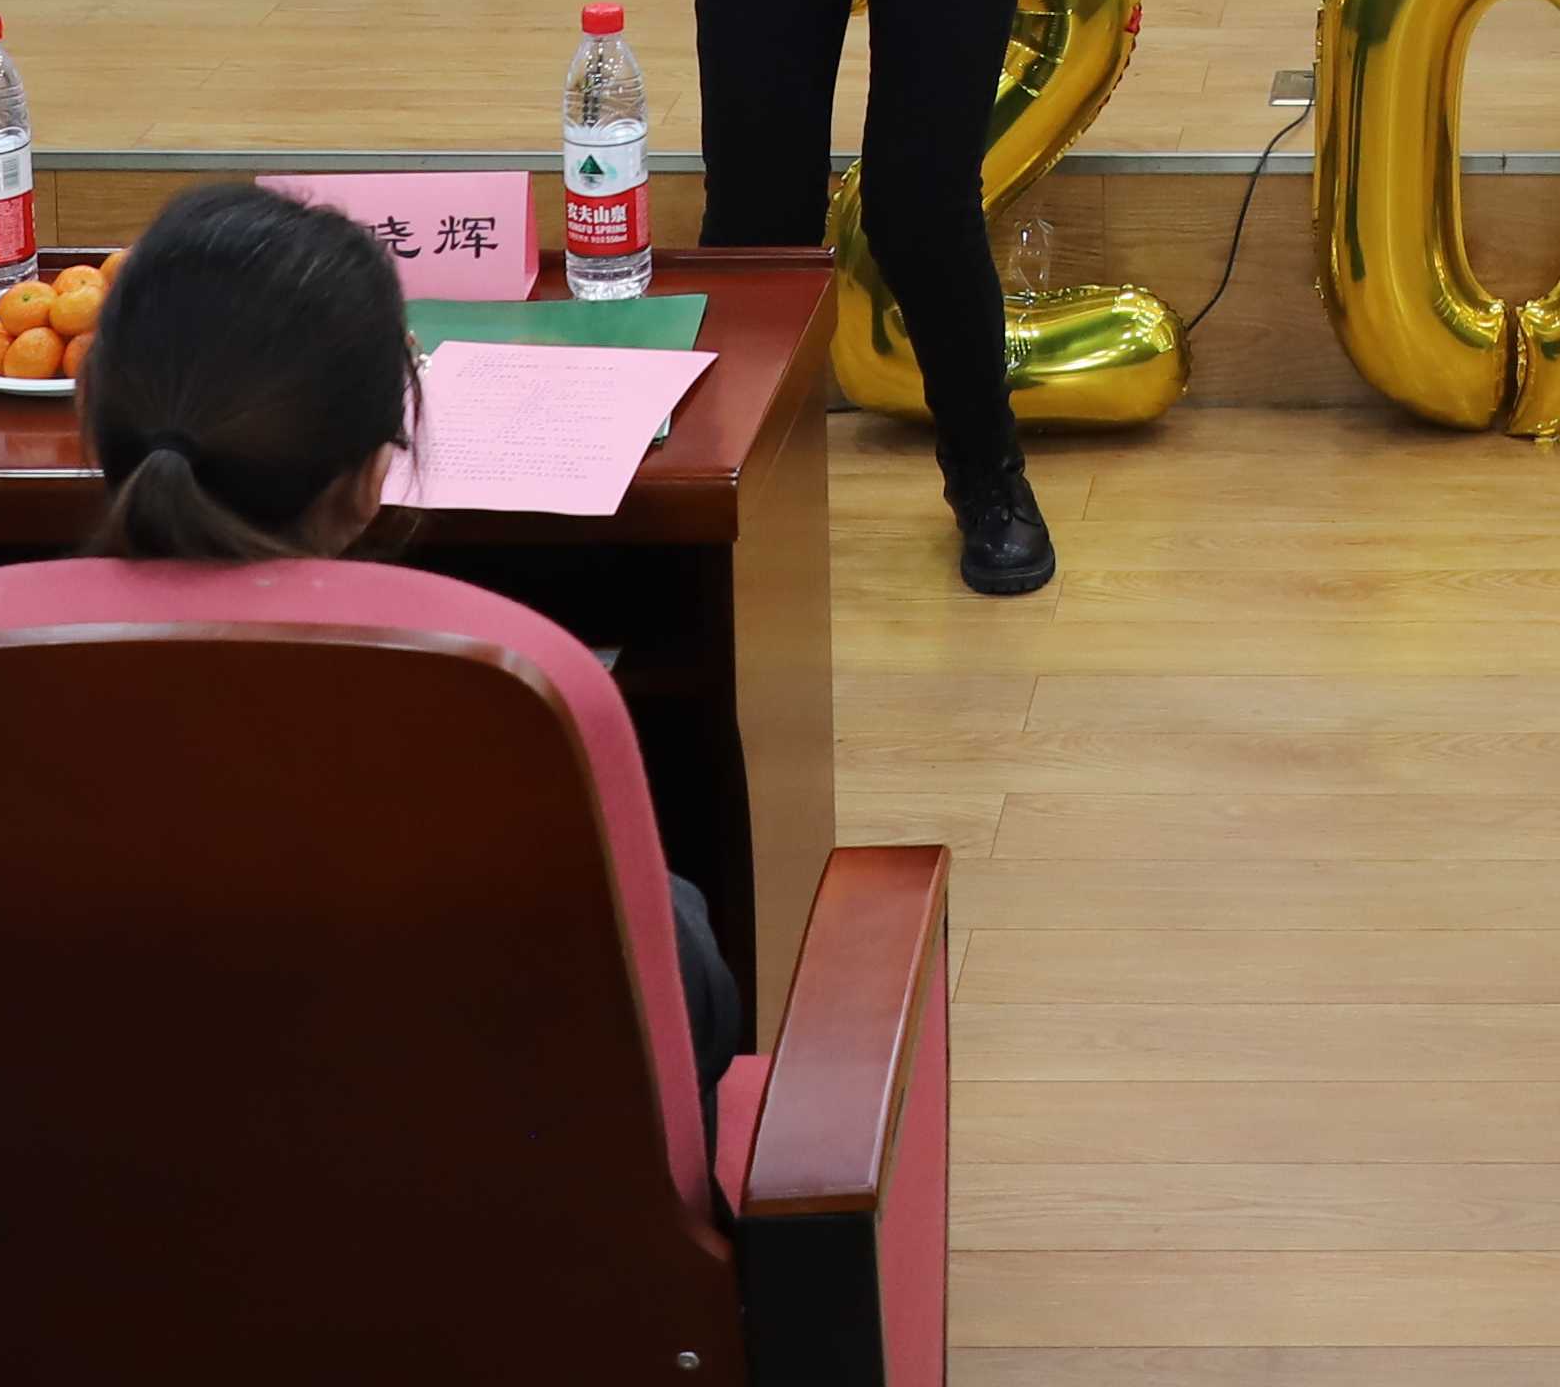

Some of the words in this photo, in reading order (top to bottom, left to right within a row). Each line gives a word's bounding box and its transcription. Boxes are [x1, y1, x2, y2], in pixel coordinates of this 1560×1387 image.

[567, 201, 628, 224] 农夫山泉
[594, 223, 628, 235] SPRING
